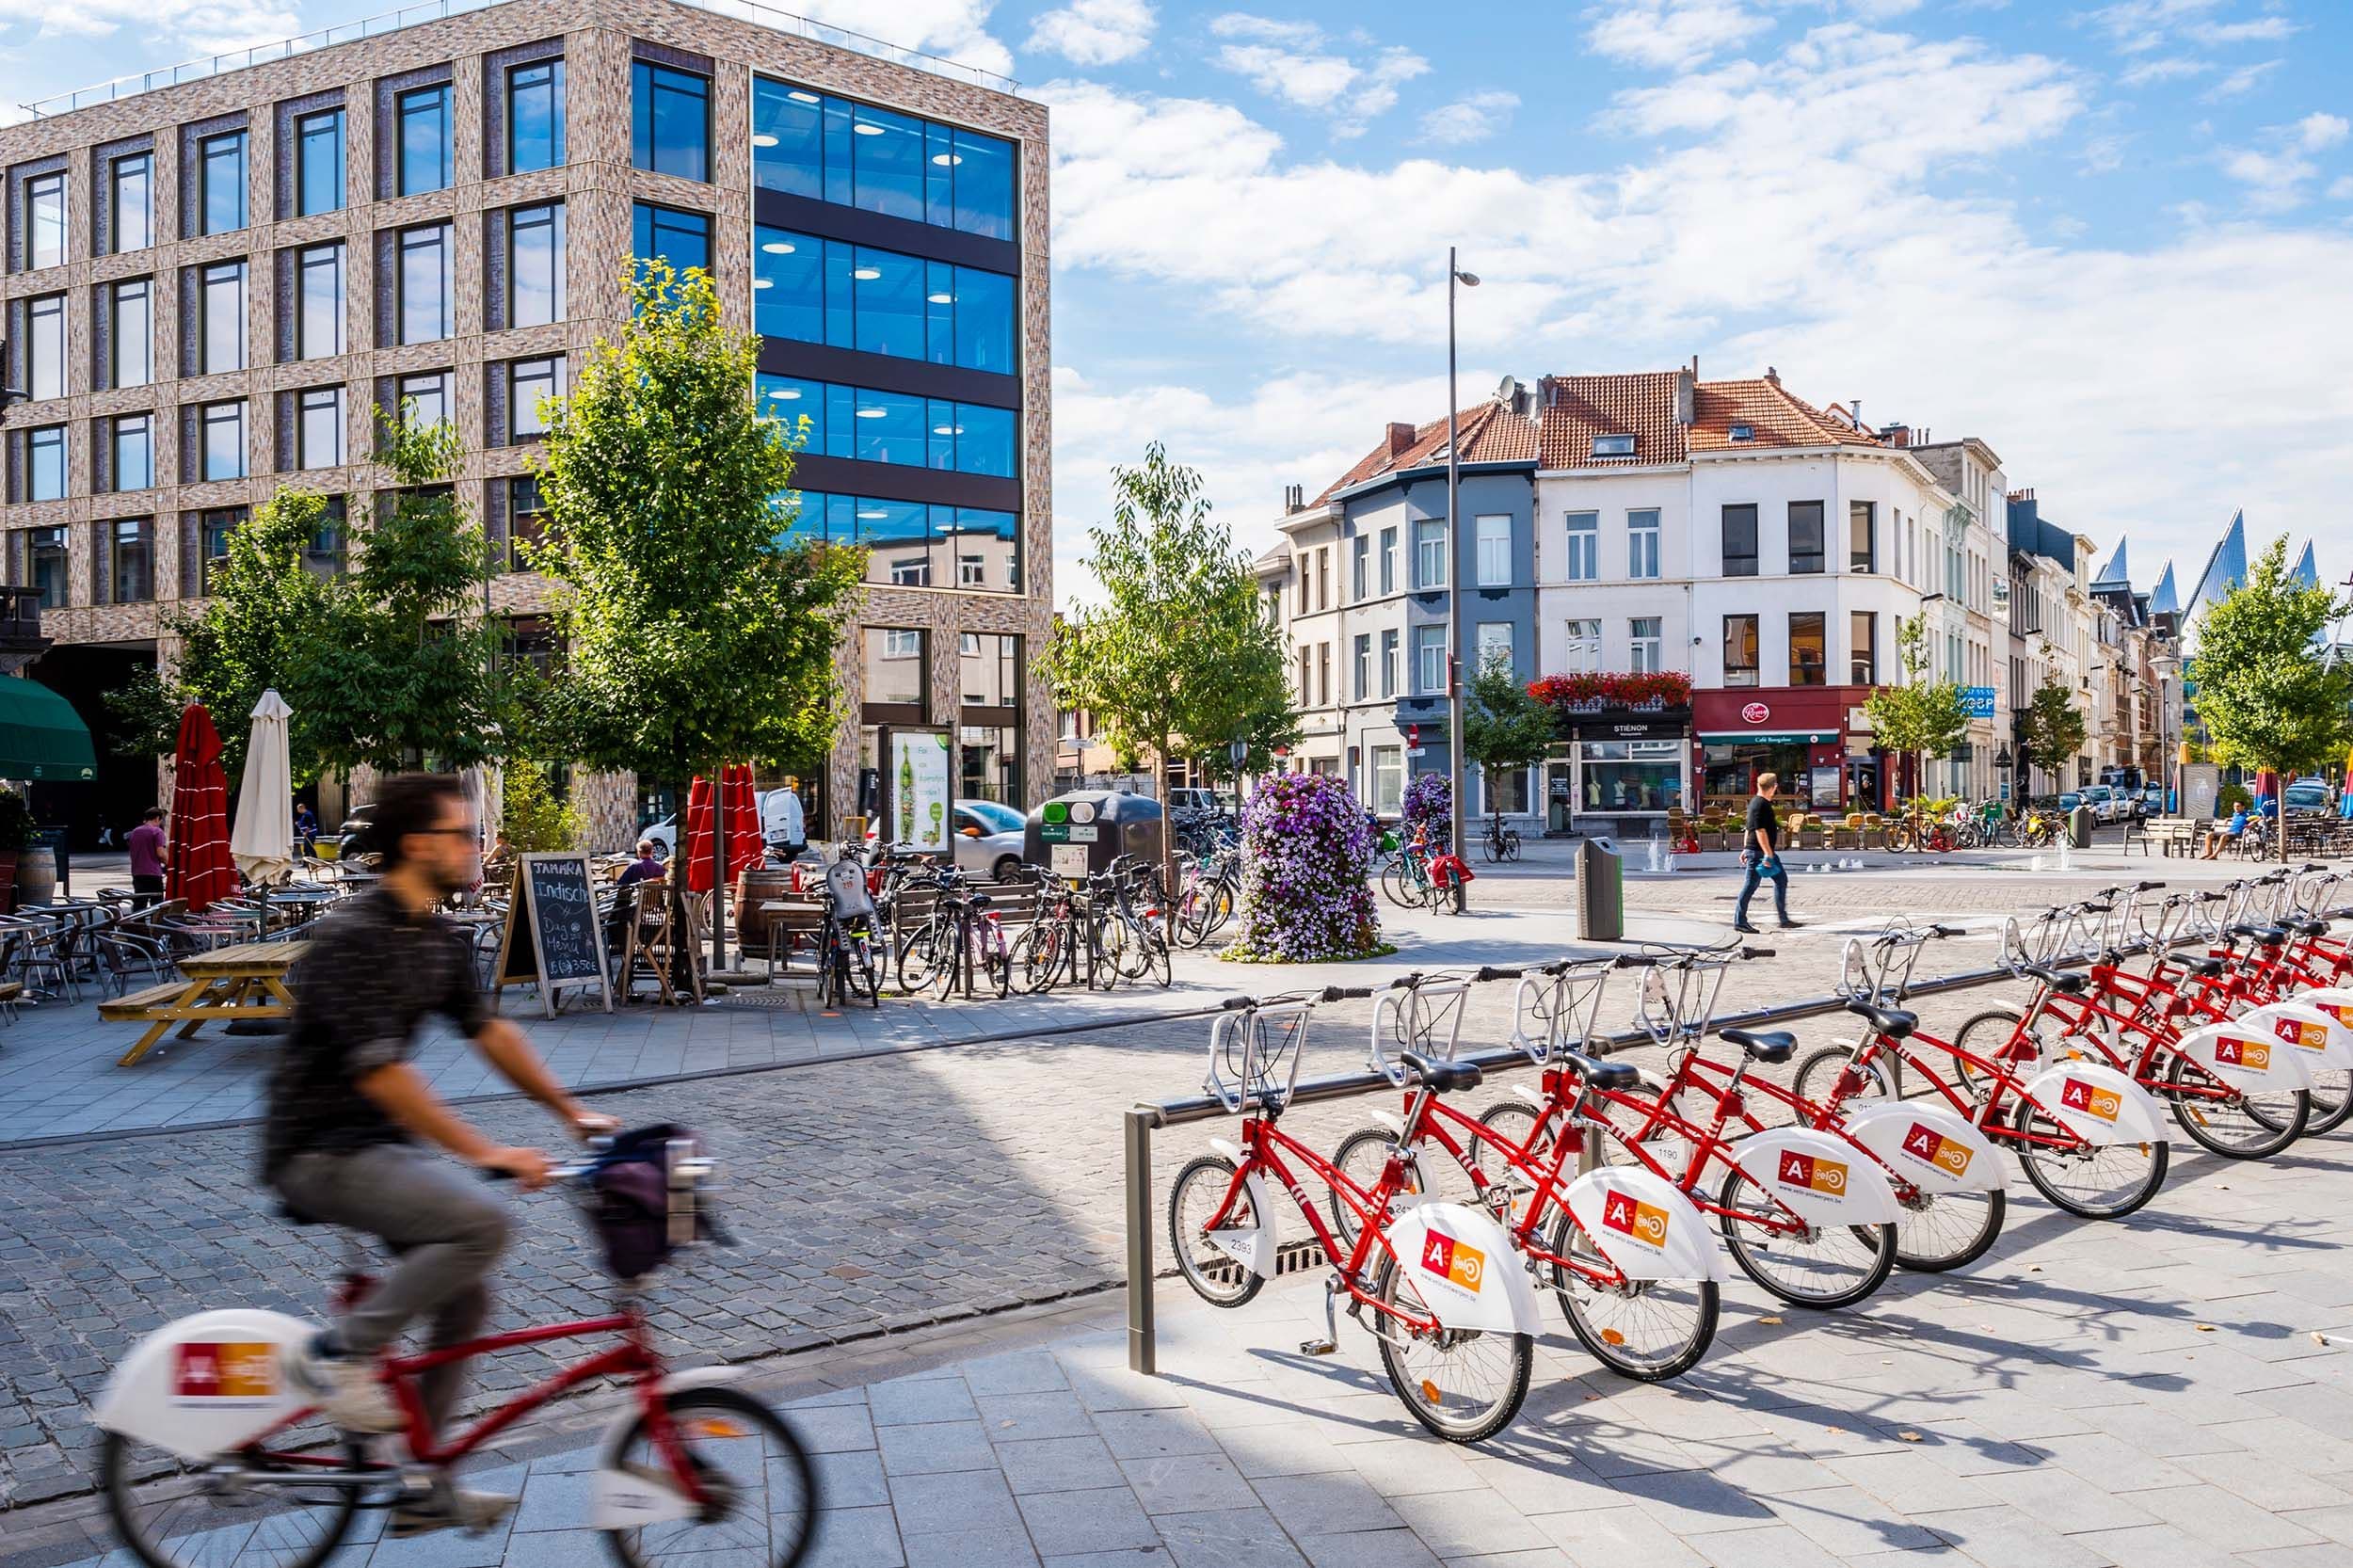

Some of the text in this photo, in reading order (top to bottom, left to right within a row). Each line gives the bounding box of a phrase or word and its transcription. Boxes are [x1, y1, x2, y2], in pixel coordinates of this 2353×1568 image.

[2281, 1024, 2294, 1039] A
[2221, 1044, 2236, 1059] A
[2068, 1087, 2083, 1105] A
[1912, 1134, 1929, 1153] A
[1658, 1148, 1678, 1160] 1190
[1786, 1160, 1804, 1180] A
[1610, 1202, 1627, 1226] A
[1231, 1239, 1252, 1255] 2393
[1428, 1241, 1445, 1268] A
